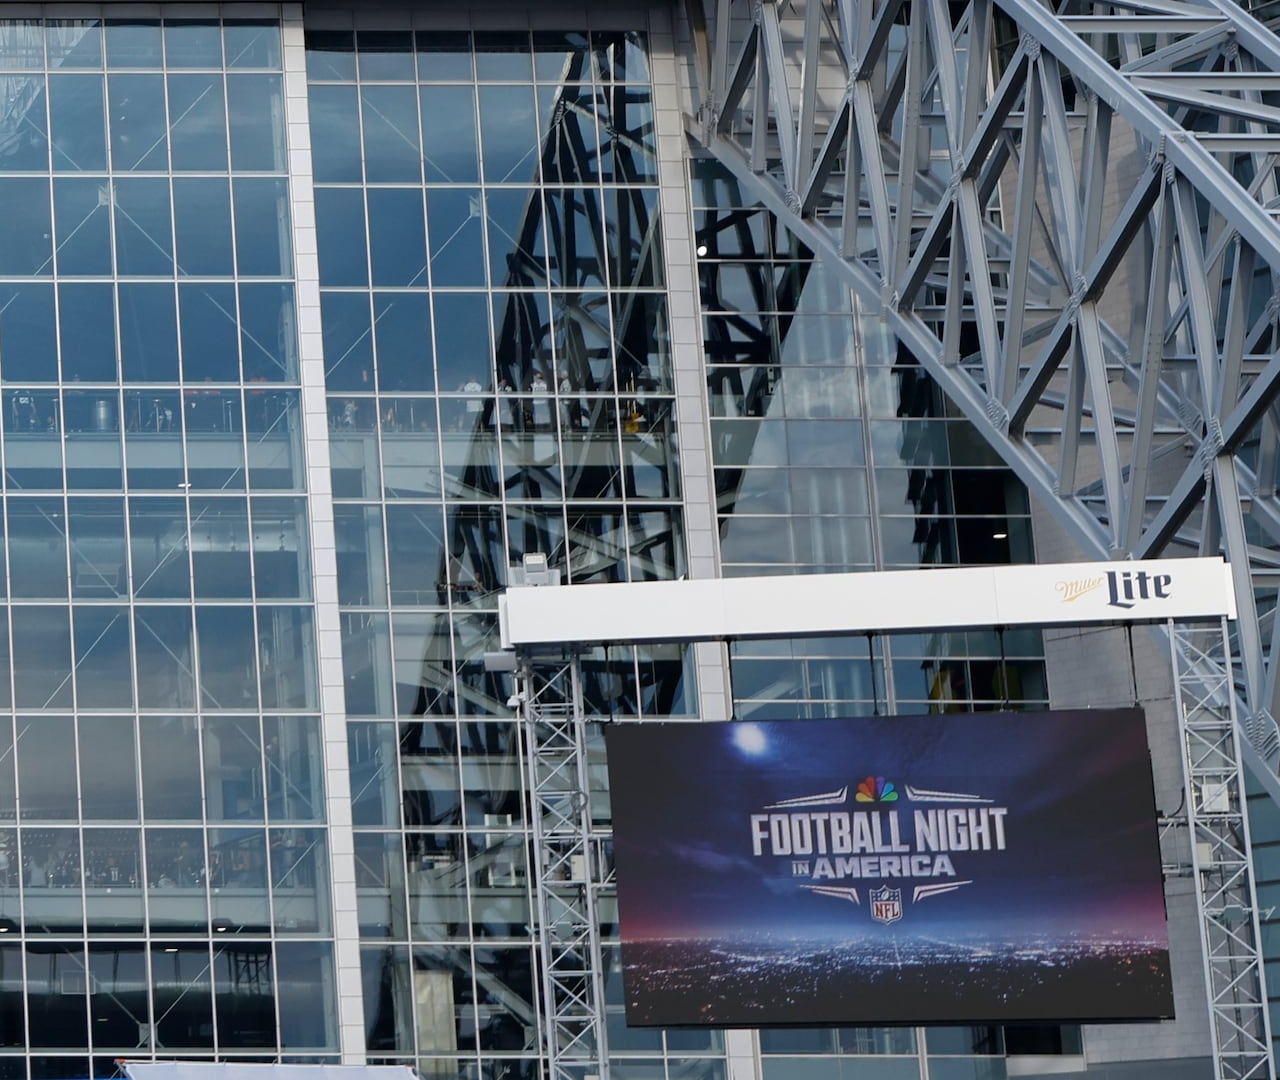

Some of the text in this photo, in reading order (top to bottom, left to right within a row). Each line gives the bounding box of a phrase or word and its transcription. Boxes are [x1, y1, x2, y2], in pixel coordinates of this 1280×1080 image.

[1055, 571, 1172, 610] Miller Lite
[750, 807, 1008, 856] FOOTBALL NIGHT
[792, 854, 957, 880] IN AMERICA
[874, 902, 899, 920] NFL
